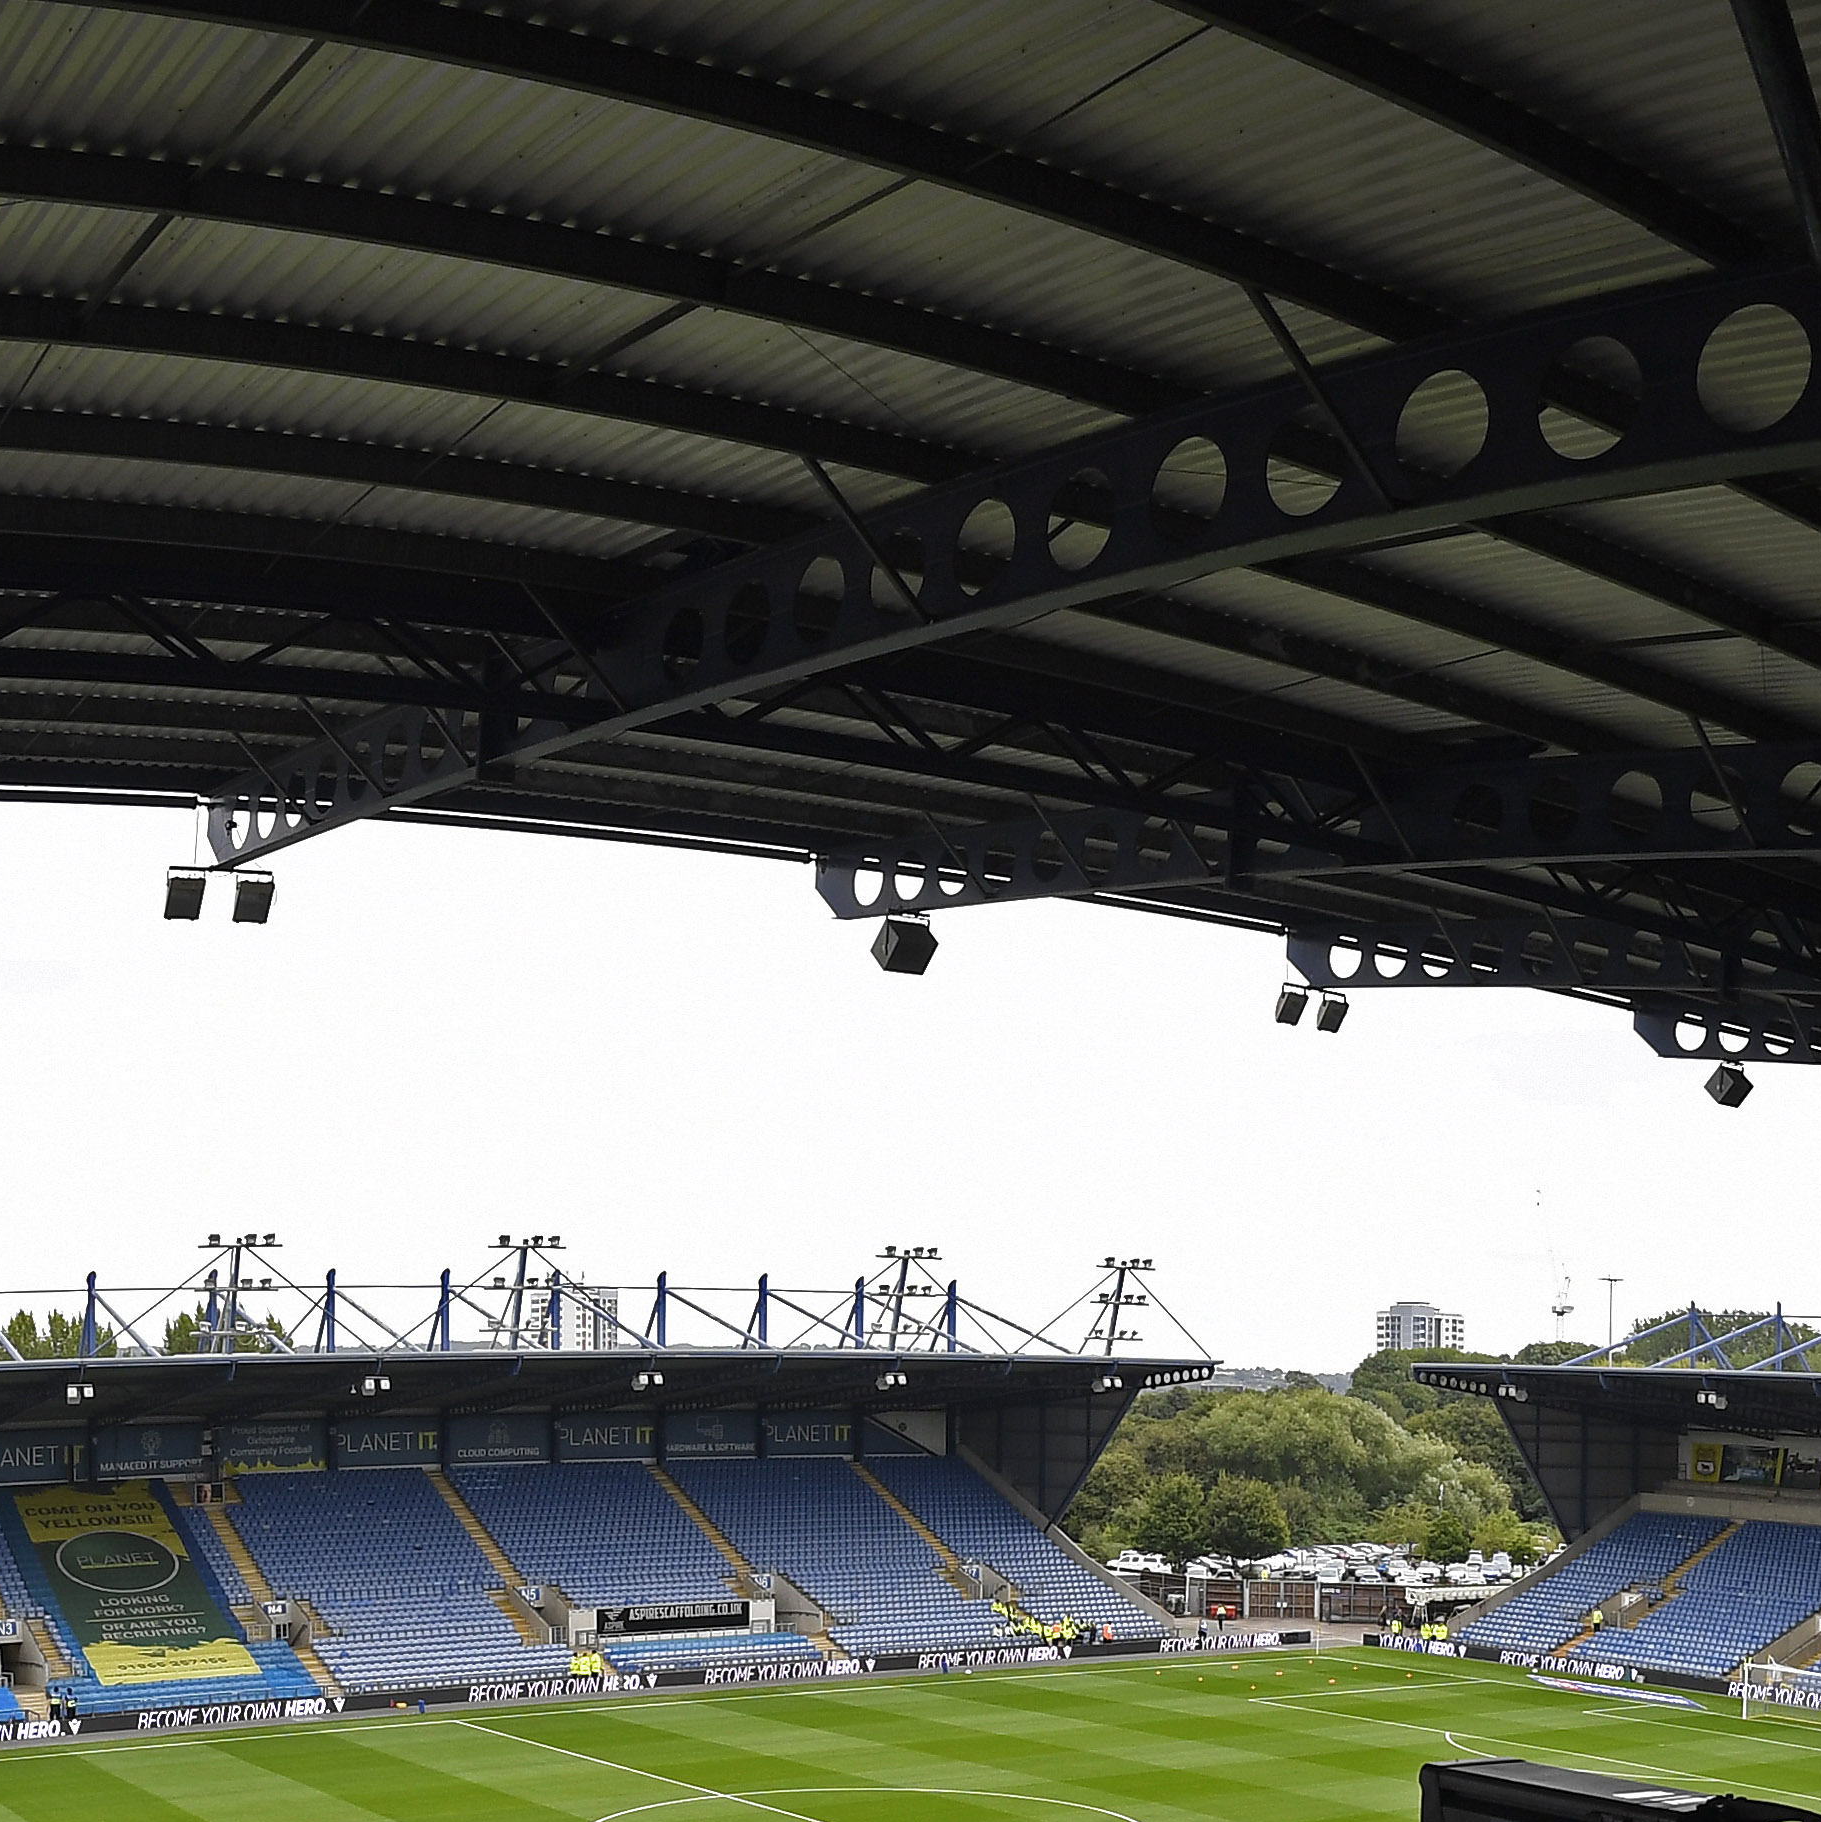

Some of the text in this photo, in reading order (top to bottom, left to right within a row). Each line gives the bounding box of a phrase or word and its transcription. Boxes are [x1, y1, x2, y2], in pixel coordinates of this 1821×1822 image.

[635, 1425, 654, 1445] IT
[834, 1423, 852, 1442] IT
[457, 1446, 540, 1459] CLOUD COMPUTING
[24, 1501, 156, 1517] COME ON YOU
[38, 1513, 154, 1530] YELLOWS!!!
[76, 1550, 155, 1568] PLANET
[99, 1593, 171, 1607] LOOKING
[93, 1603, 186, 1618] FOR WORK?
[628, 1603, 744, 1622] ASPIRESCAFFOLDING.CO.UK
[101, 1617, 198, 1632] OR ARE YOU
[101, 1625, 208, 1641] RECRUITING?
[1253, 1632, 1282, 1647] HERO.
[966, 1649, 997, 1666] YOUR
[1027, 1645, 1062, 1662] HERO.
[1428, 1640, 1458, 1659] HERO.
[704, 1658, 864, 1685] BECOME YOUR OWN HERO.
[468, 1681, 526, 1703] BECOME
[526, 1677, 564, 1698] YOUR
[564, 1675, 600, 1696] OWN
[137, 1697, 331, 1730] BECOME YOUR OWN HERO.
[16, 1719, 66, 1741] HERO.
